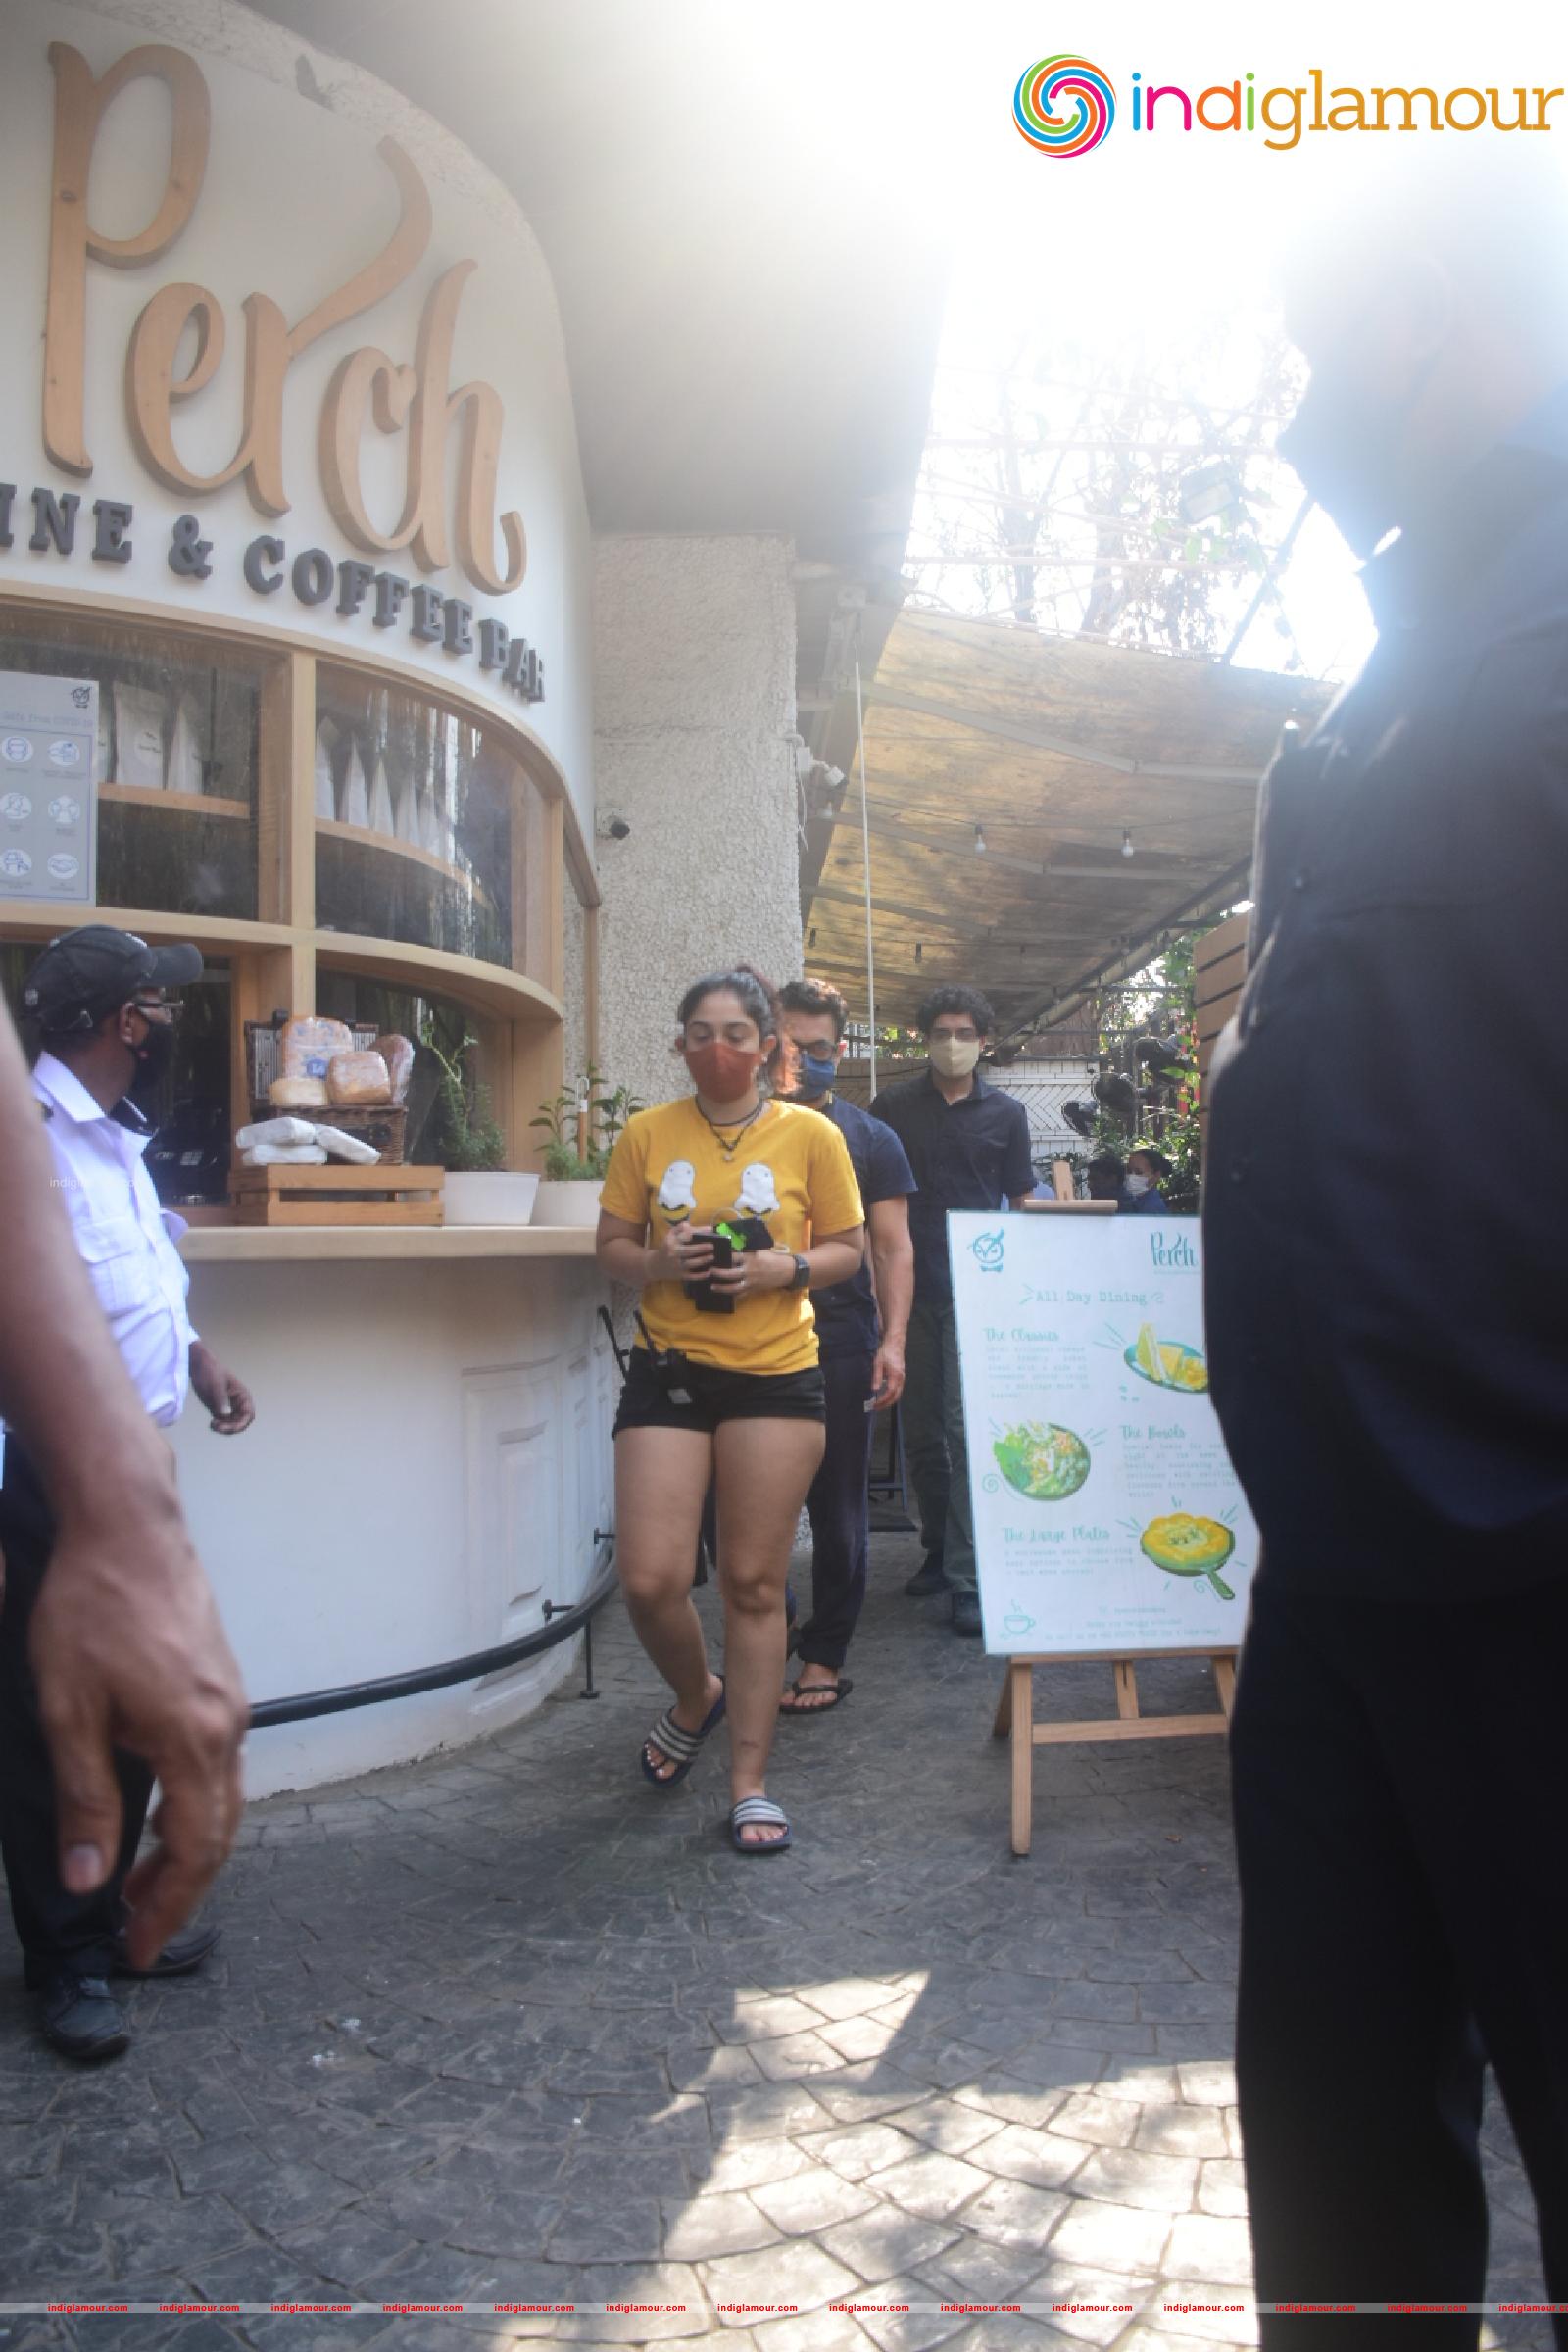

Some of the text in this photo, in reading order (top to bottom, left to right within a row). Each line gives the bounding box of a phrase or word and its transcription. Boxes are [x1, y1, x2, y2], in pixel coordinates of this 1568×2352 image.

[43, 41, 526, 596] Perch
[168, 514, 213, 580] &
[243, 534, 472, 656] COFFEE
[478, 618, 545, 703] BAR
[1036, 1290, 1148, 1306] All Day Dining
[1150, 1230, 1199, 1266] Perch
